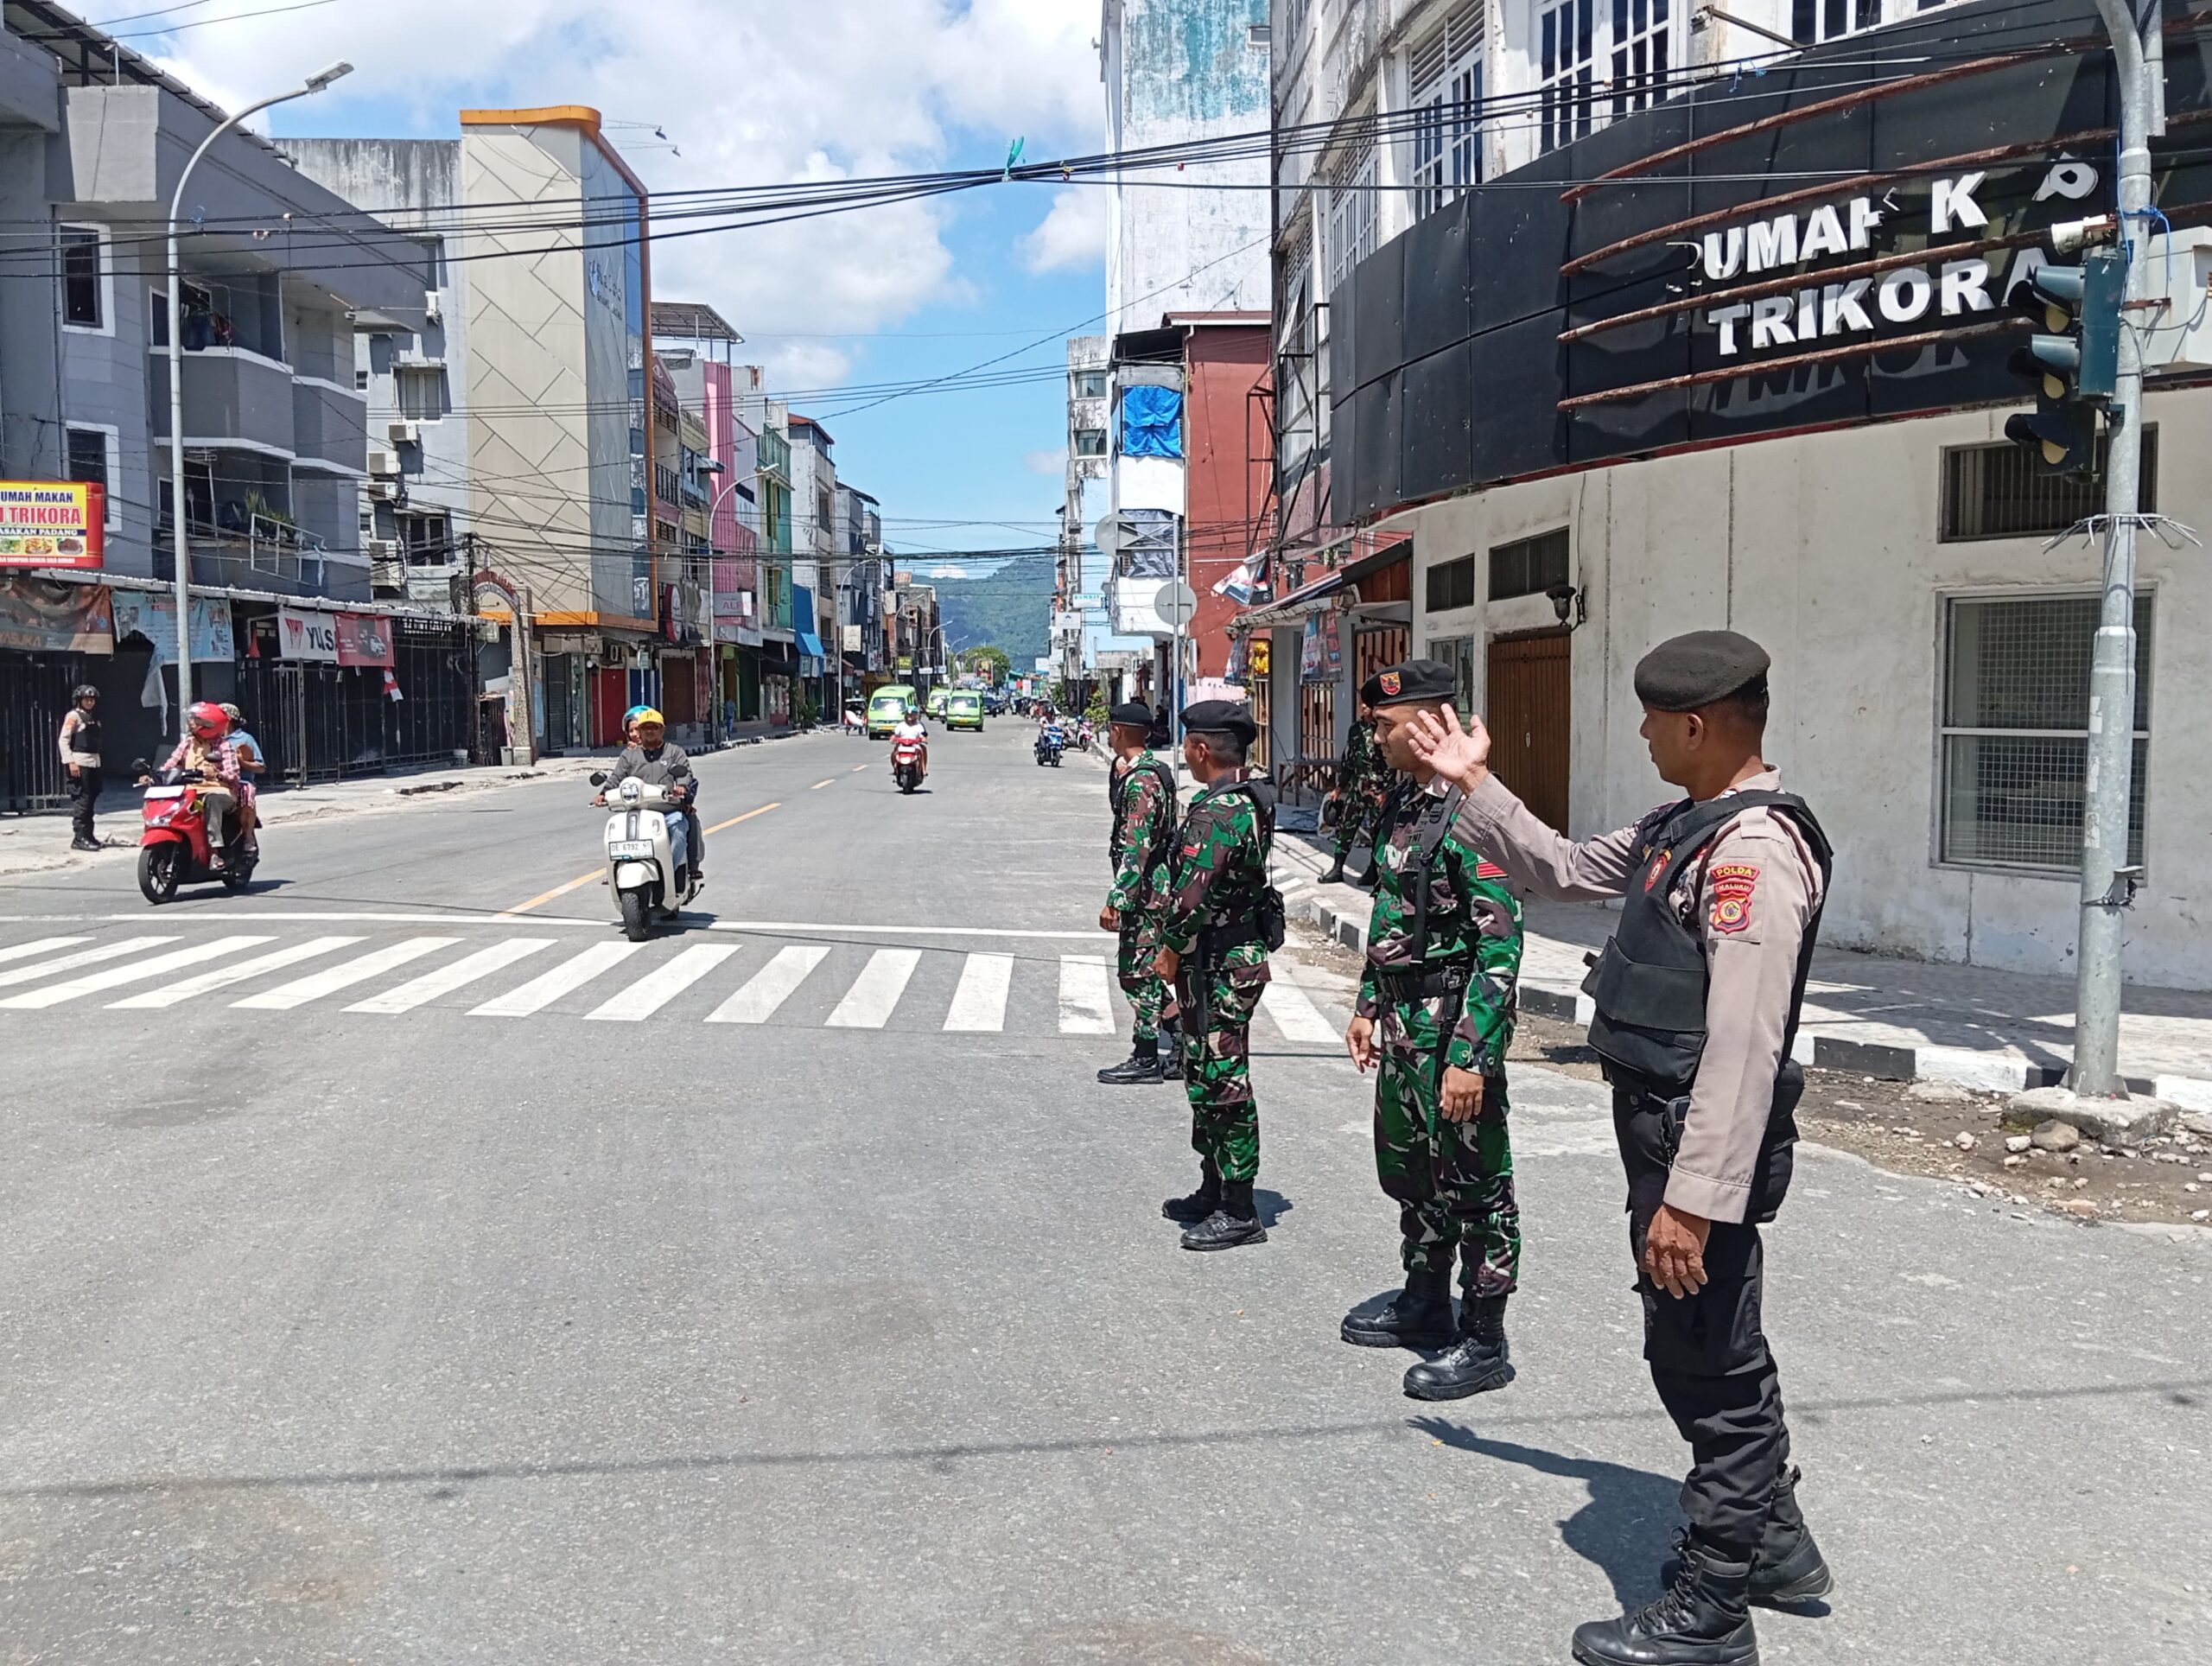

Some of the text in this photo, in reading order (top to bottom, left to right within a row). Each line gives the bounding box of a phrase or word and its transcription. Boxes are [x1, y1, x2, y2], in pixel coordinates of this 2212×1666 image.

[35, 493, 73, 502] MAKAN
[10, 507, 81, 524] TRIKORA
[1716, 867, 1752, 876] POLDA
